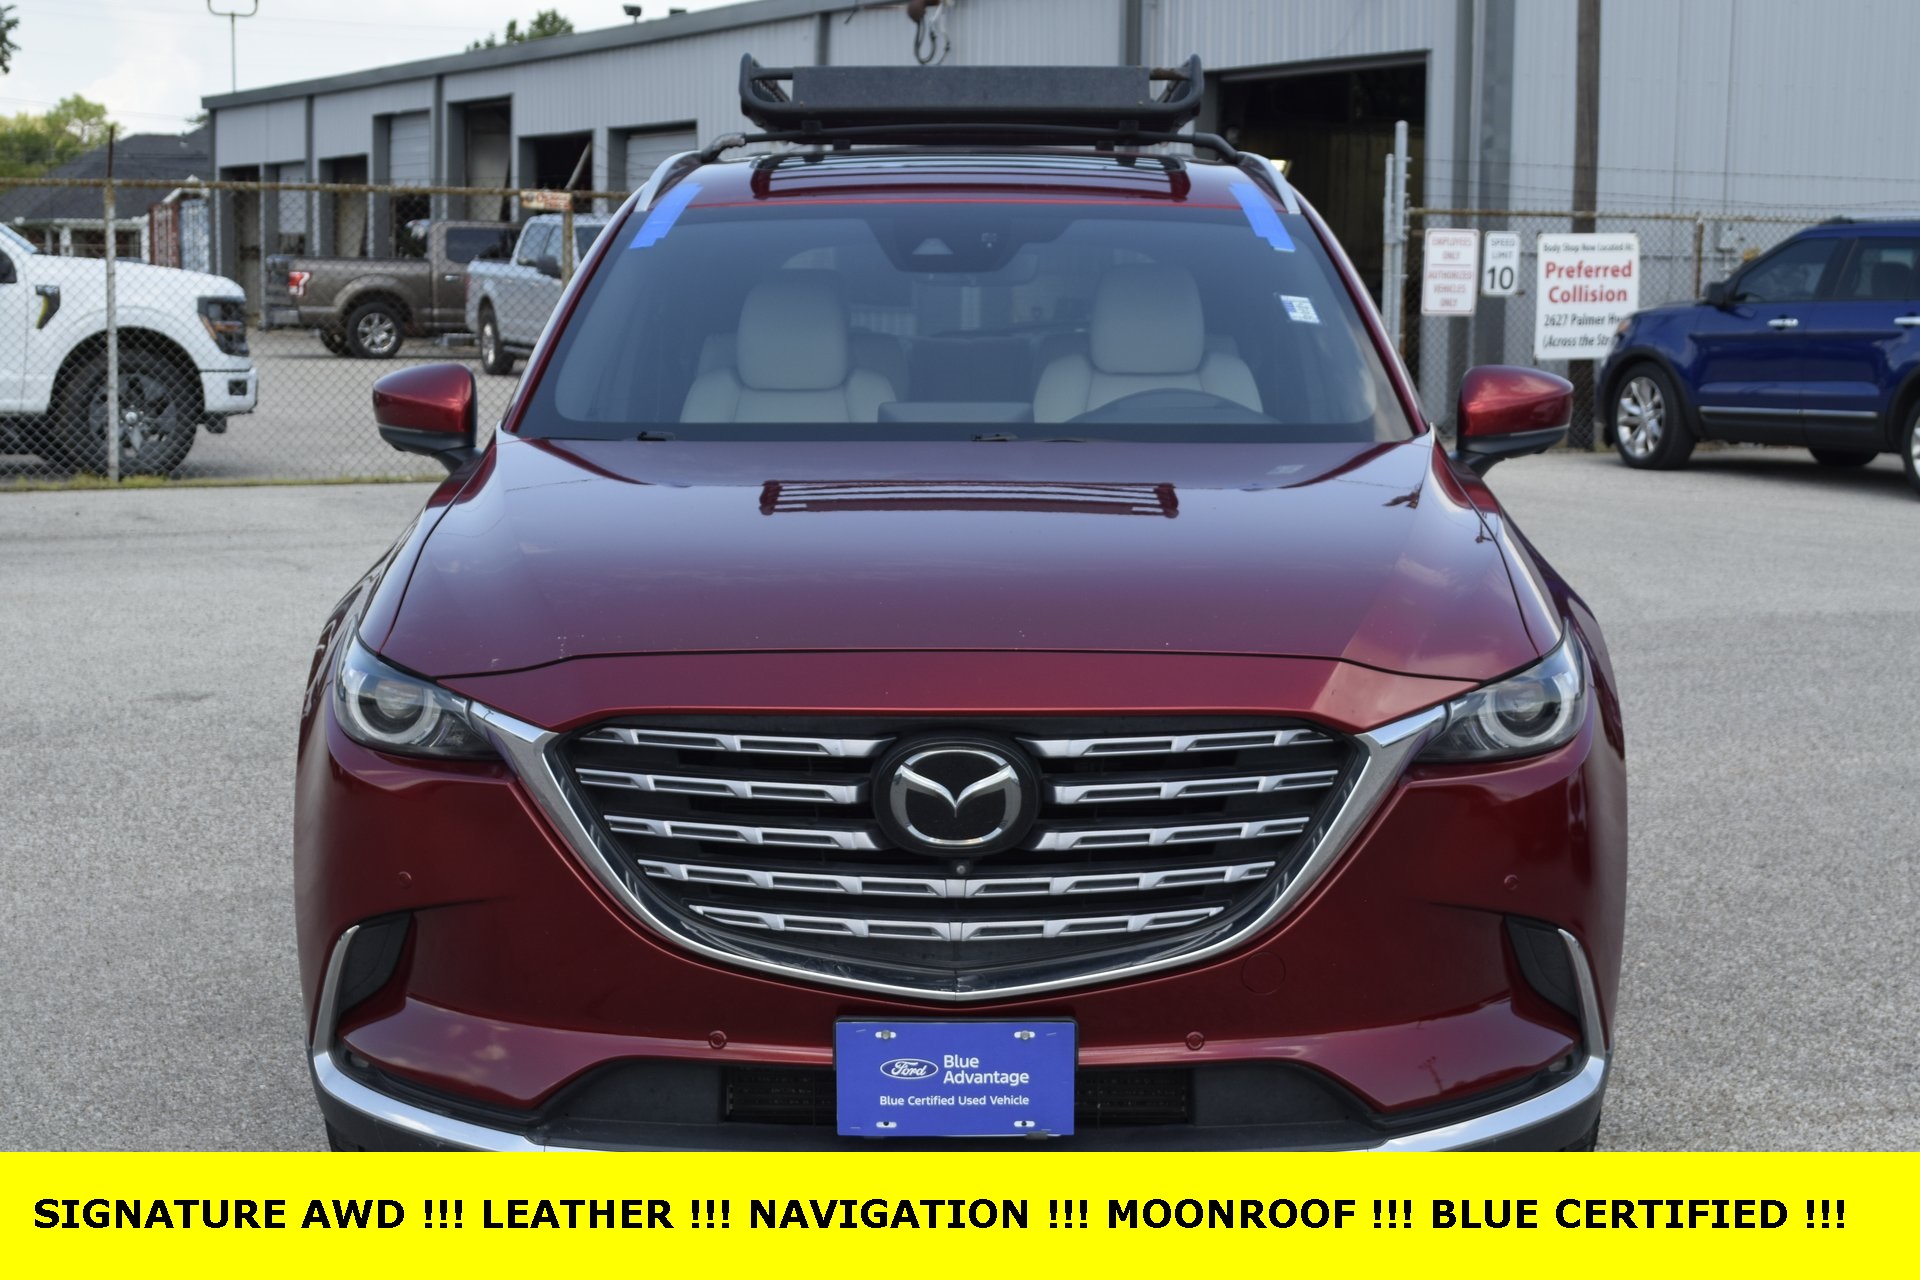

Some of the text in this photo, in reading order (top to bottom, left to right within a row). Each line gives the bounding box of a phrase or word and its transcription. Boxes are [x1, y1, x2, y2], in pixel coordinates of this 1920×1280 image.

[1491, 238, 1515, 247] SPEED
[1491, 251, 1513, 260] LIMIT
[1545, 260, 1632, 278] Preferred
[1487, 266, 1514, 290] 10
[1548, 284, 1628, 303] Collision
[1544, 313, 1568, 327] 2627
[1570, 313, 1605, 326] Palmer
[1578, 334, 1595, 346] the
[891, 1060, 928, 1077] Ford
[943, 1054, 980, 1069] Blue
[943, 1070, 1030, 1087] Advantage
[879, 1095, 1030, 1106] Blue Certified Used Vehicle
